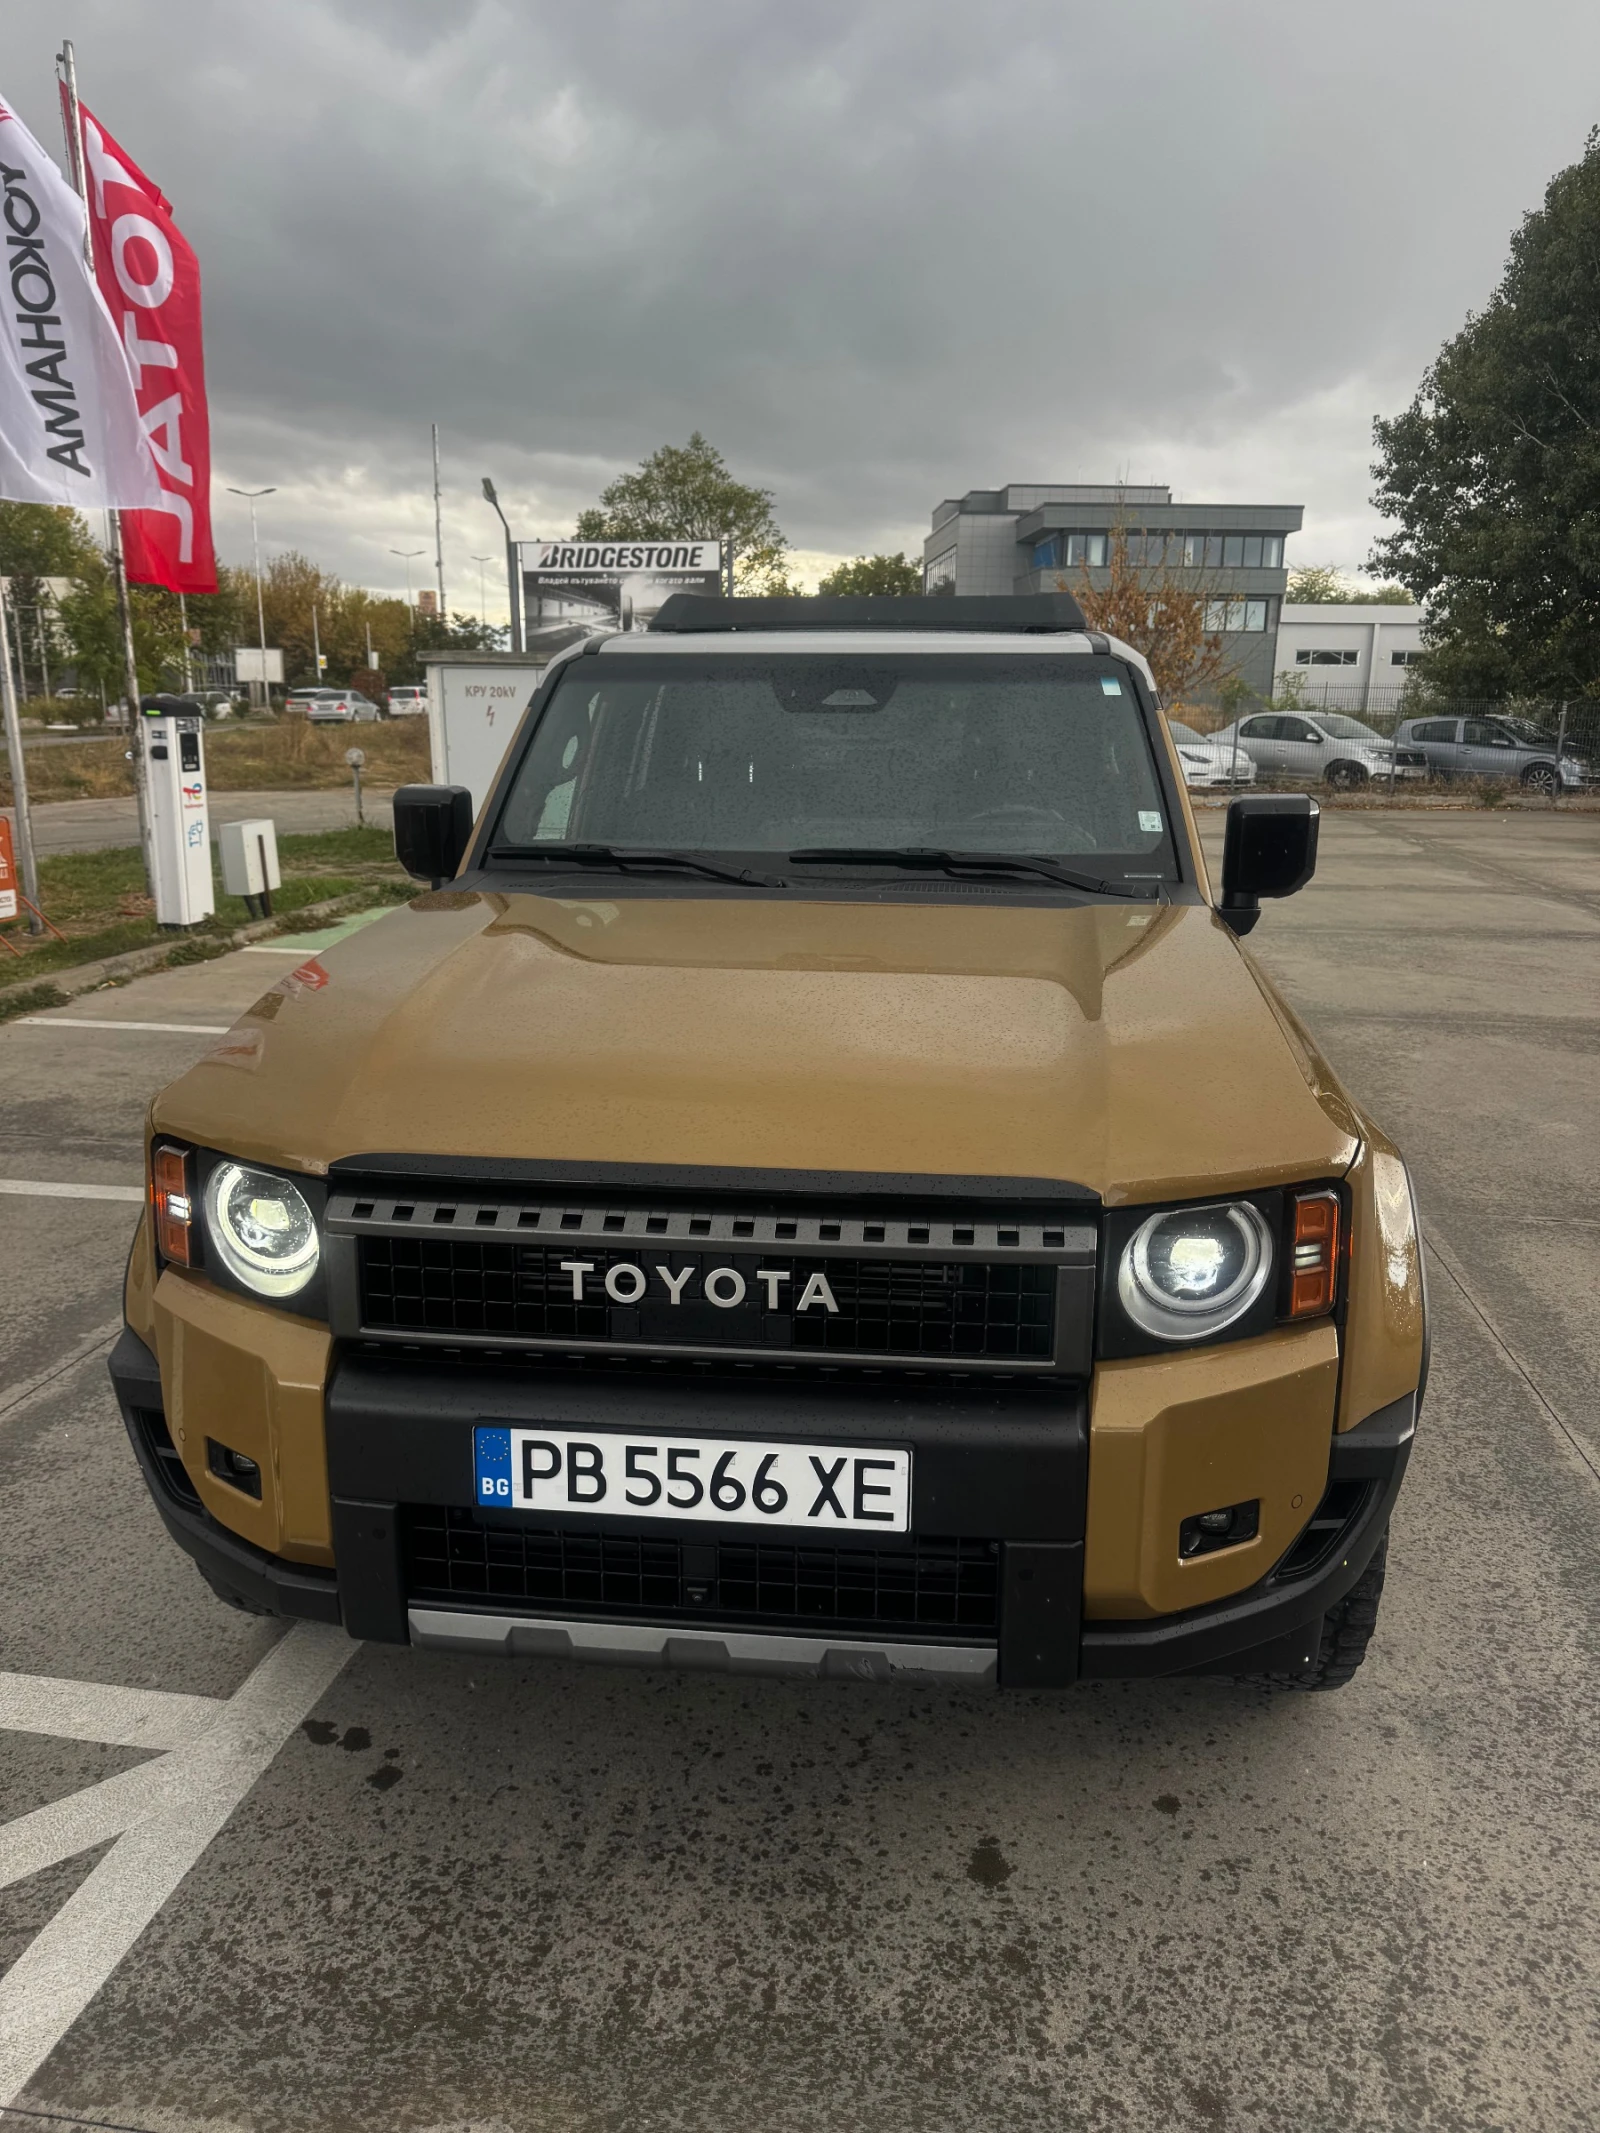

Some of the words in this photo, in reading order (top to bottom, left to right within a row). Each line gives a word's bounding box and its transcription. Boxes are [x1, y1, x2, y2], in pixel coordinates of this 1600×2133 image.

[538, 545, 704, 569] BRIDGESTONE
[465, 685, 488, 698] КРУ
[489, 686, 516, 698] 20kV
[560, 1261, 839, 1313] TOYOTA
[481, 1476, 510, 1496] BG
[521, 1439, 608, 1503] PB
[624, 1445, 789, 1514] 5566
[807, 1455, 896, 1522] XE
